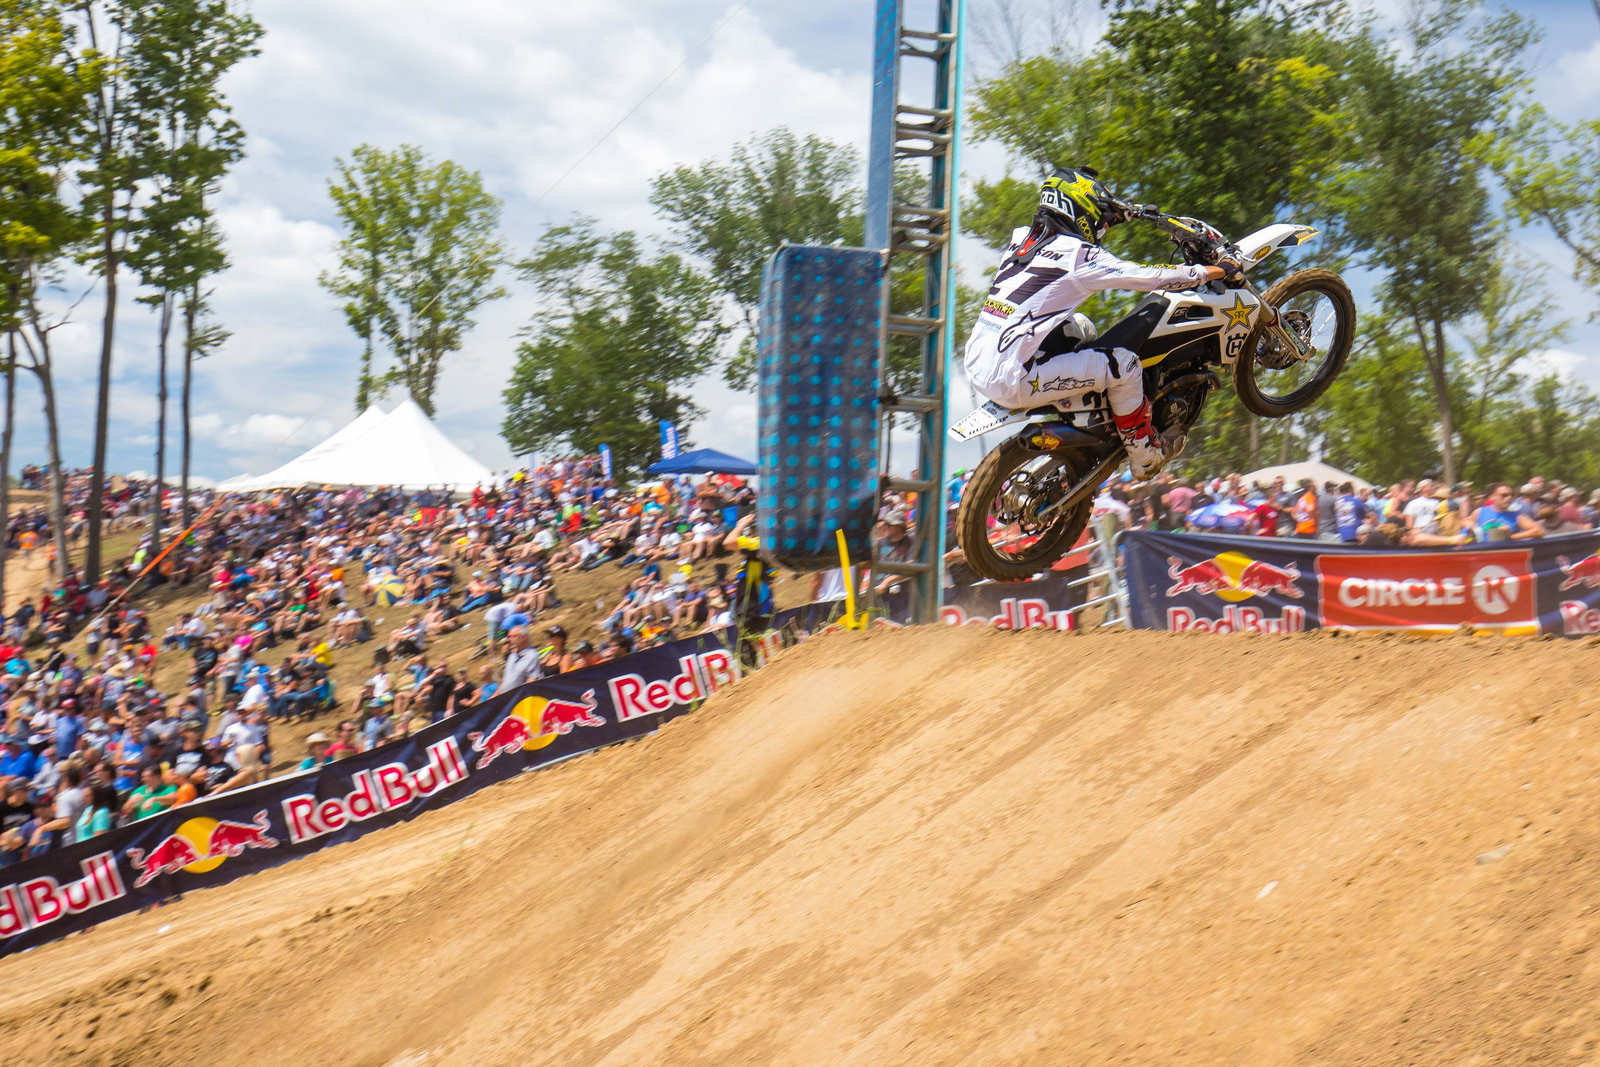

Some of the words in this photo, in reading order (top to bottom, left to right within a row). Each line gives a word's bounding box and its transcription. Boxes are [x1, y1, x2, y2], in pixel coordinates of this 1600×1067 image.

[1338, 577, 1466, 607] CIRCLE
[284, 769, 382, 843] Red
[375, 737, 467, 810] Bull
[22, 852, 123, 925] Bull
